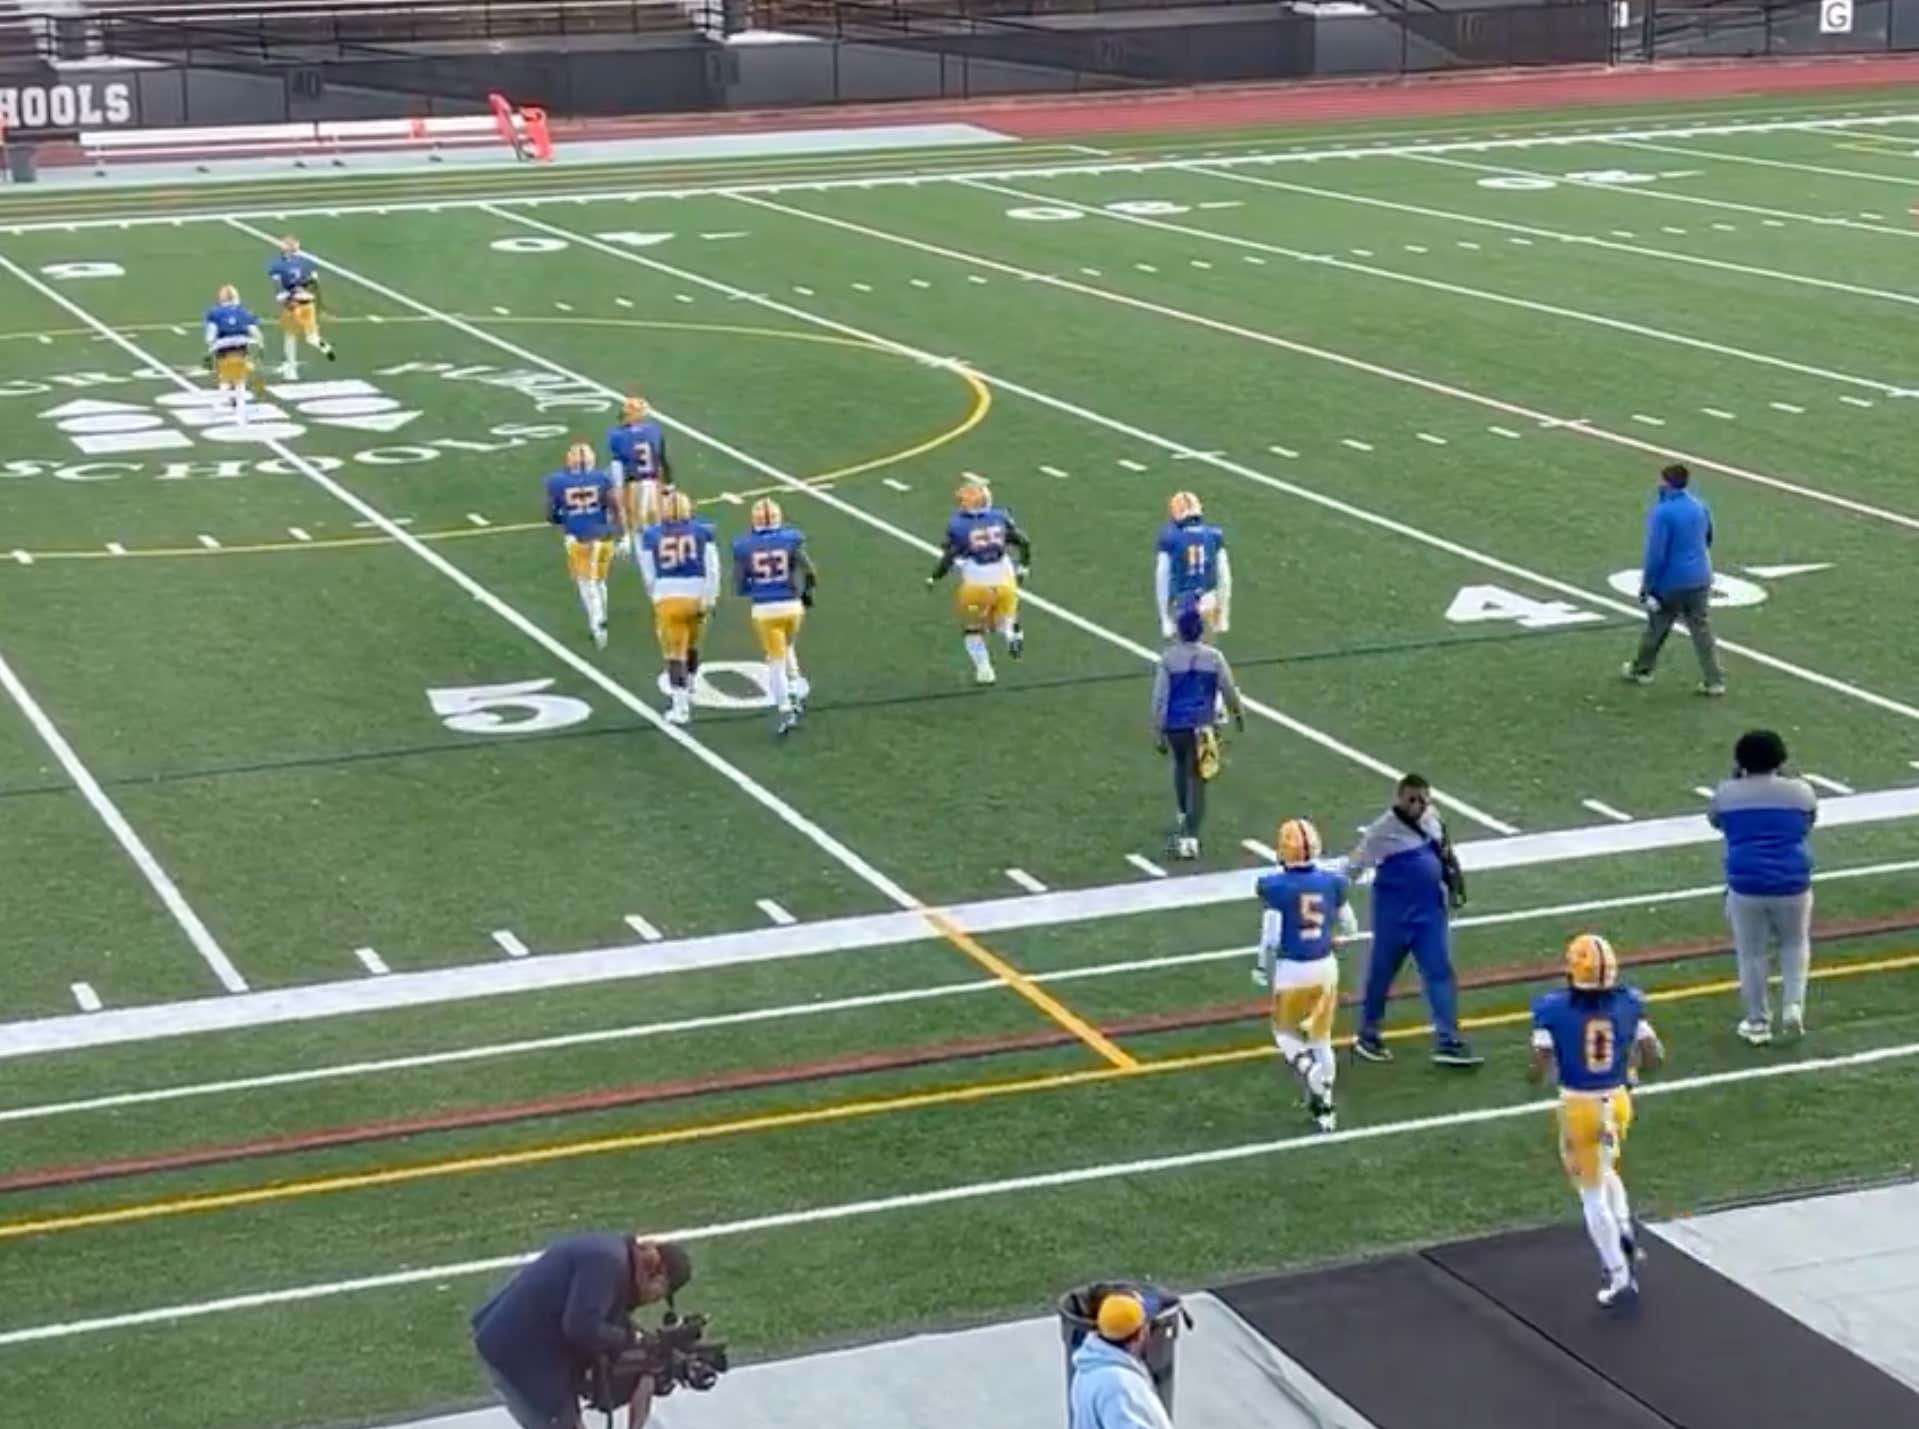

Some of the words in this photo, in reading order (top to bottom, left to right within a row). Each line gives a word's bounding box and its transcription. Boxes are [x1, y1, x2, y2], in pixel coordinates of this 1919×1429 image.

[1825, 2, 1848, 28] G
[0, 423, 569, 480] SCHOOLS
[634, 441, 655, 474] 3
[751, 550, 790, 584] 53
[1299, 893, 1325, 940] 5
[1584, 1017, 1614, 1074] 0
